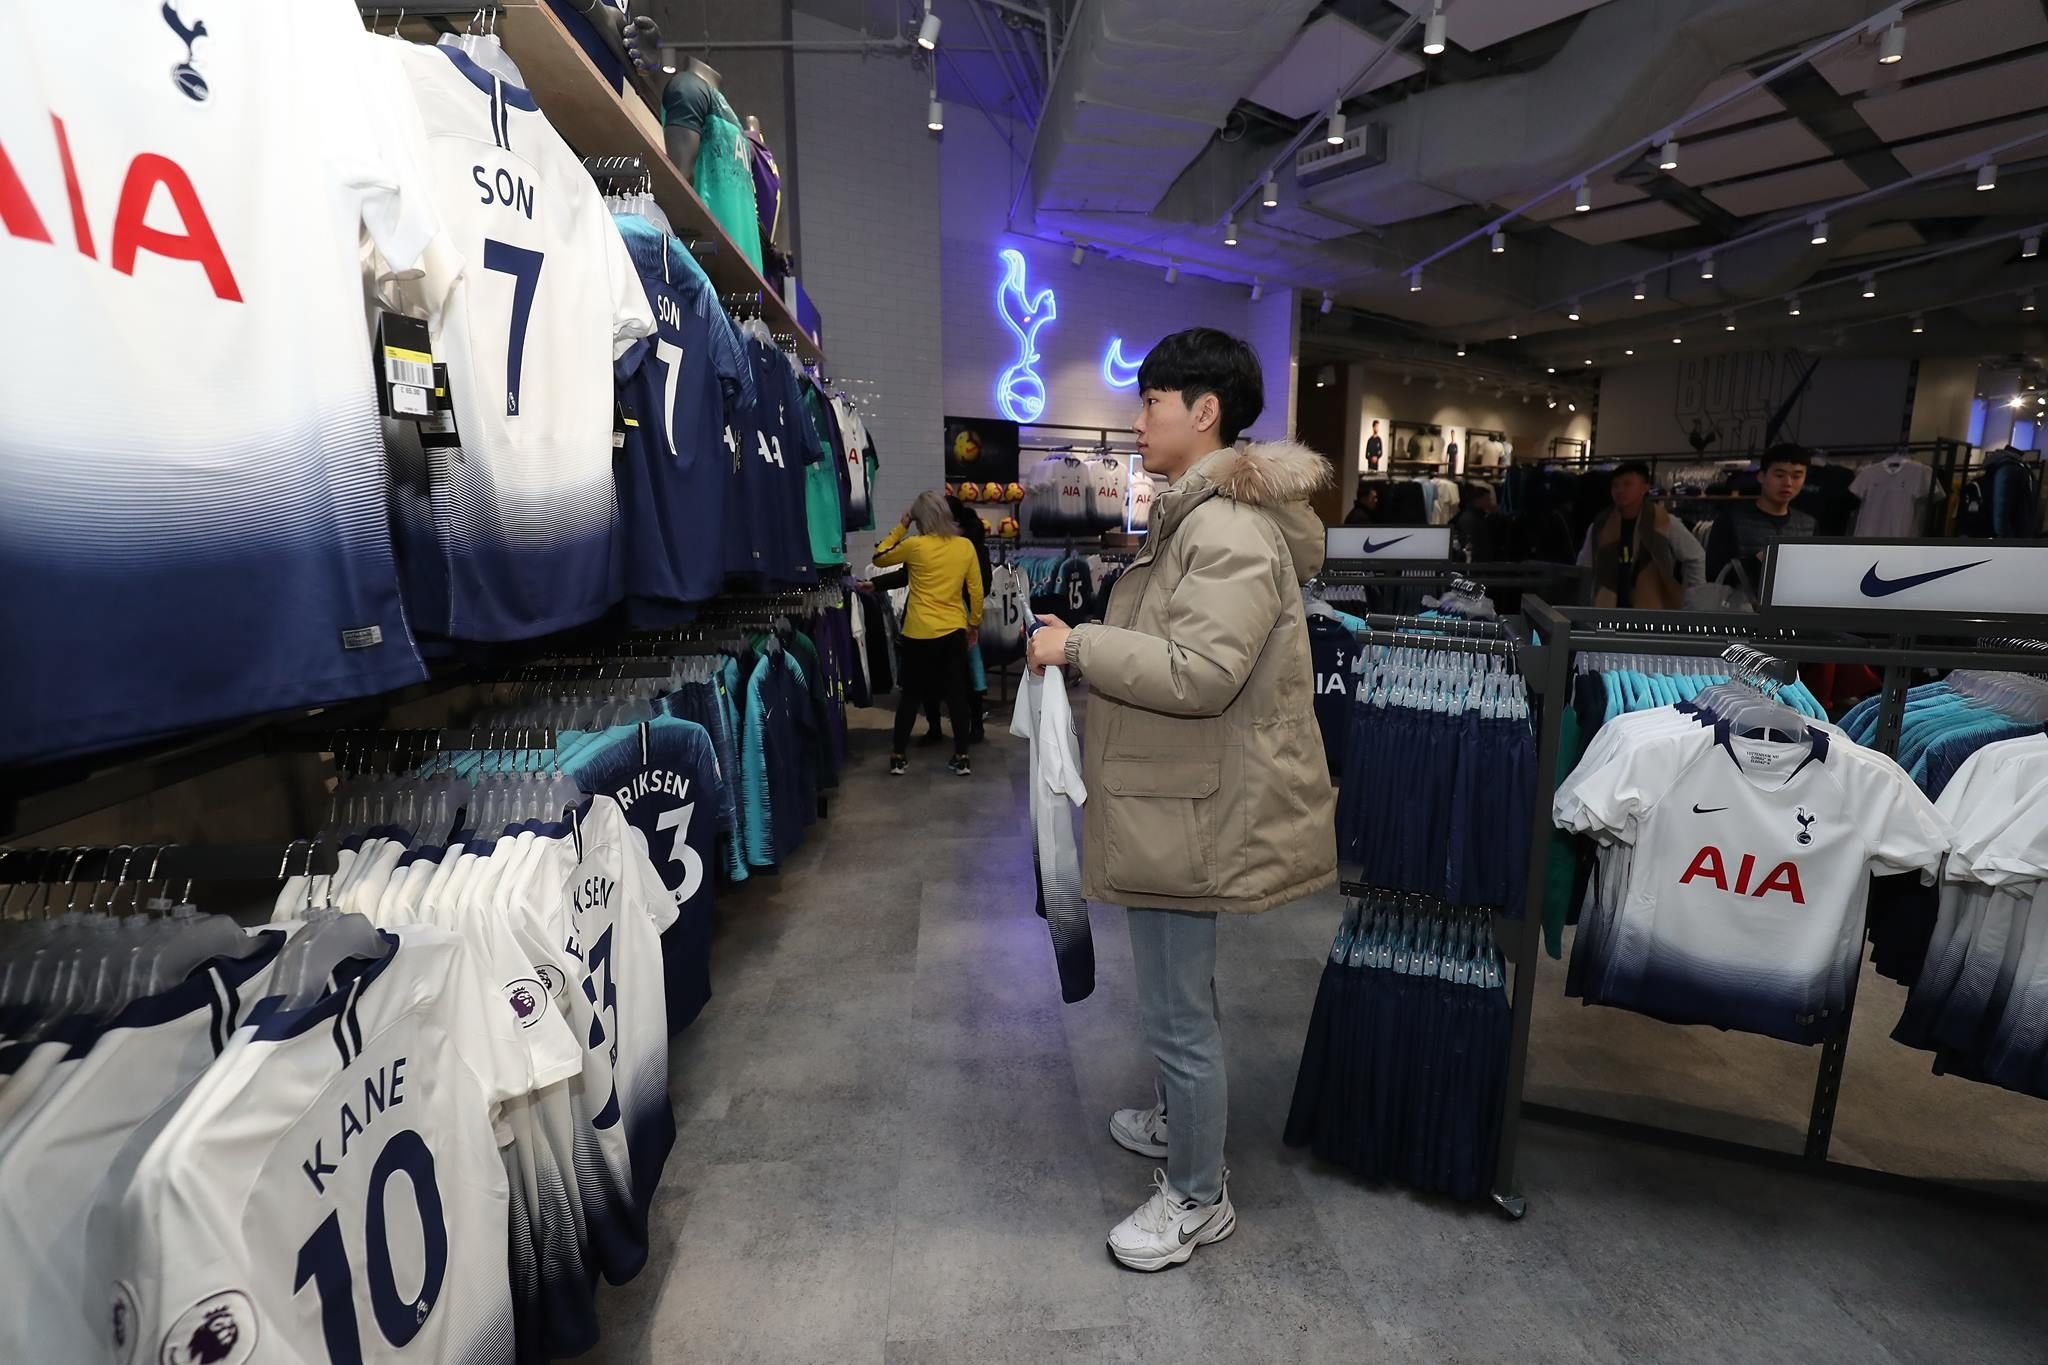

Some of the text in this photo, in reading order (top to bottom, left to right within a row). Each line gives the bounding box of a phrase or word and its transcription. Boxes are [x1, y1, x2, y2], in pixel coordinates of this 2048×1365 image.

[734, 133, 750, 172] AI
[472, 165, 534, 220] SON
[483, 238, 545, 417] 7
[657, 294, 680, 331] SON
[656, 338, 684, 456] 7
[1062, 485, 1081, 497] AIA
[1098, 486, 1118, 498] AIA
[1002, 591, 1019, 626] 15
[1068, 580, 1083, 610] 15
[1317, 672, 1347, 695] IA
[616, 769, 690, 811] RIKSEN
[1679, 845, 1806, 905] AIA
[565, 876, 614, 963] EKSEN
[302, 1057, 407, 1195] KANE
[293, 1129, 447, 1365] 10
